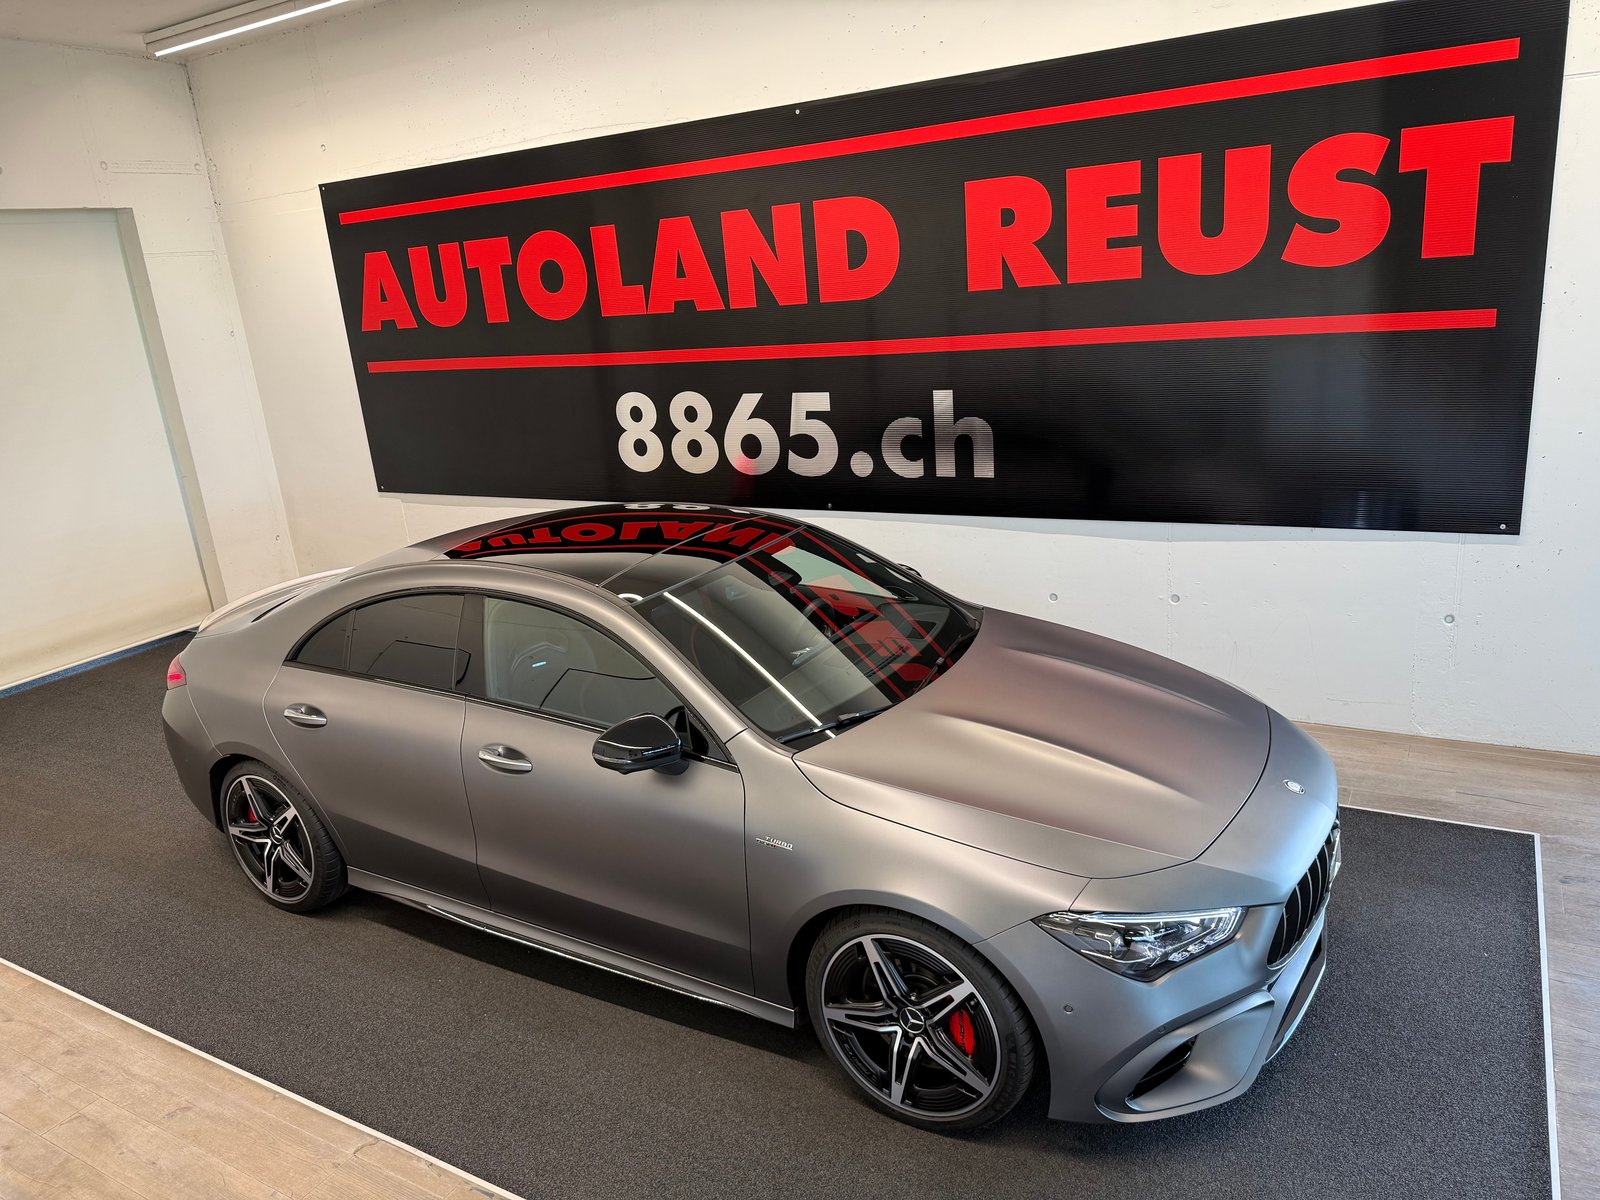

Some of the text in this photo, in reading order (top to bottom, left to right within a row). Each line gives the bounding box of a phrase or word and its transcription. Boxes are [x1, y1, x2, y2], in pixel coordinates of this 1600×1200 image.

[361, 115, 1515, 332] AUTOLAND REUST
[615, 389, 995, 479] 8865.ch
[765, 835, 793, 849] TURBO
